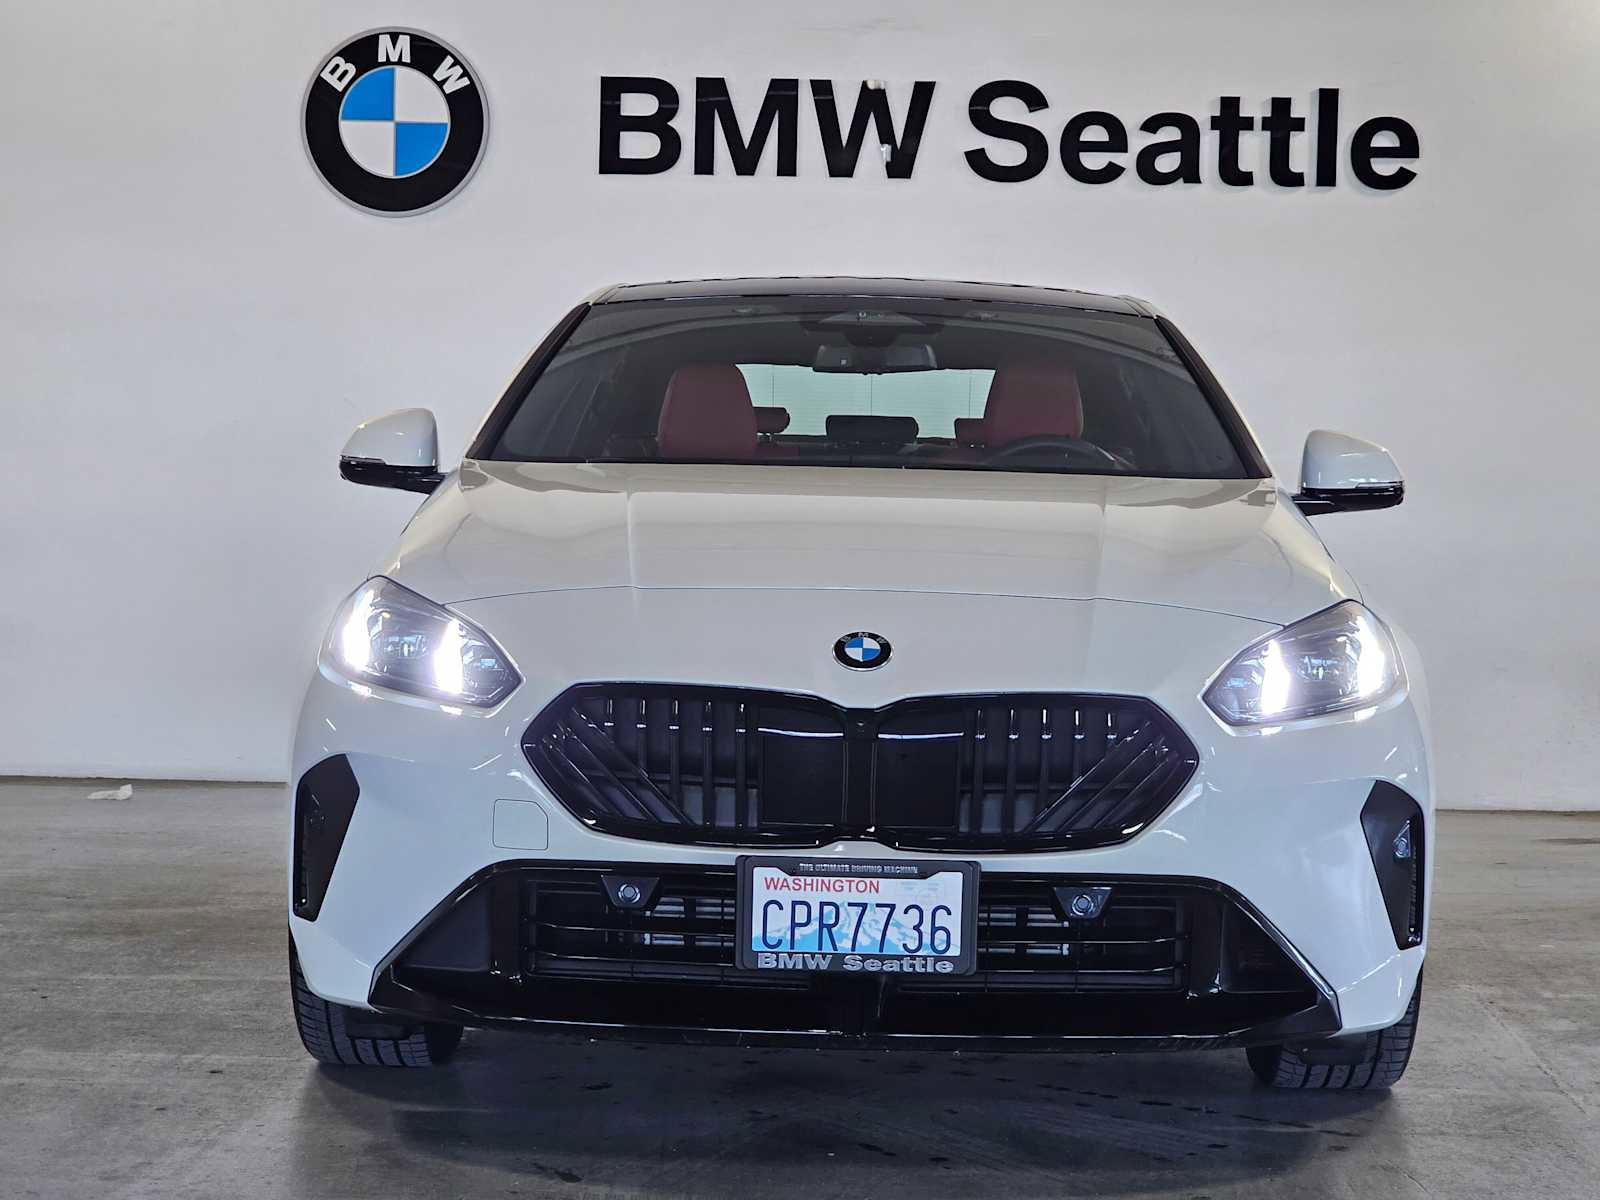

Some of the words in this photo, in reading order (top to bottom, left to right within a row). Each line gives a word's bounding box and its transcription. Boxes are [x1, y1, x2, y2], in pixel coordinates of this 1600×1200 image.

[319, 33, 470, 95] BMW
[598, 76, 936, 179] BMW
[964, 79, 1421, 190] Seattle
[764, 877, 880, 894] WASHINGTON
[799, 863, 814, 871] THE
[815, 864, 850, 872] ULTIMATE
[761, 900, 952, 955] CPR7736
[757, 953, 833, 970] BMW
[842, 955, 954, 974] Seattle
